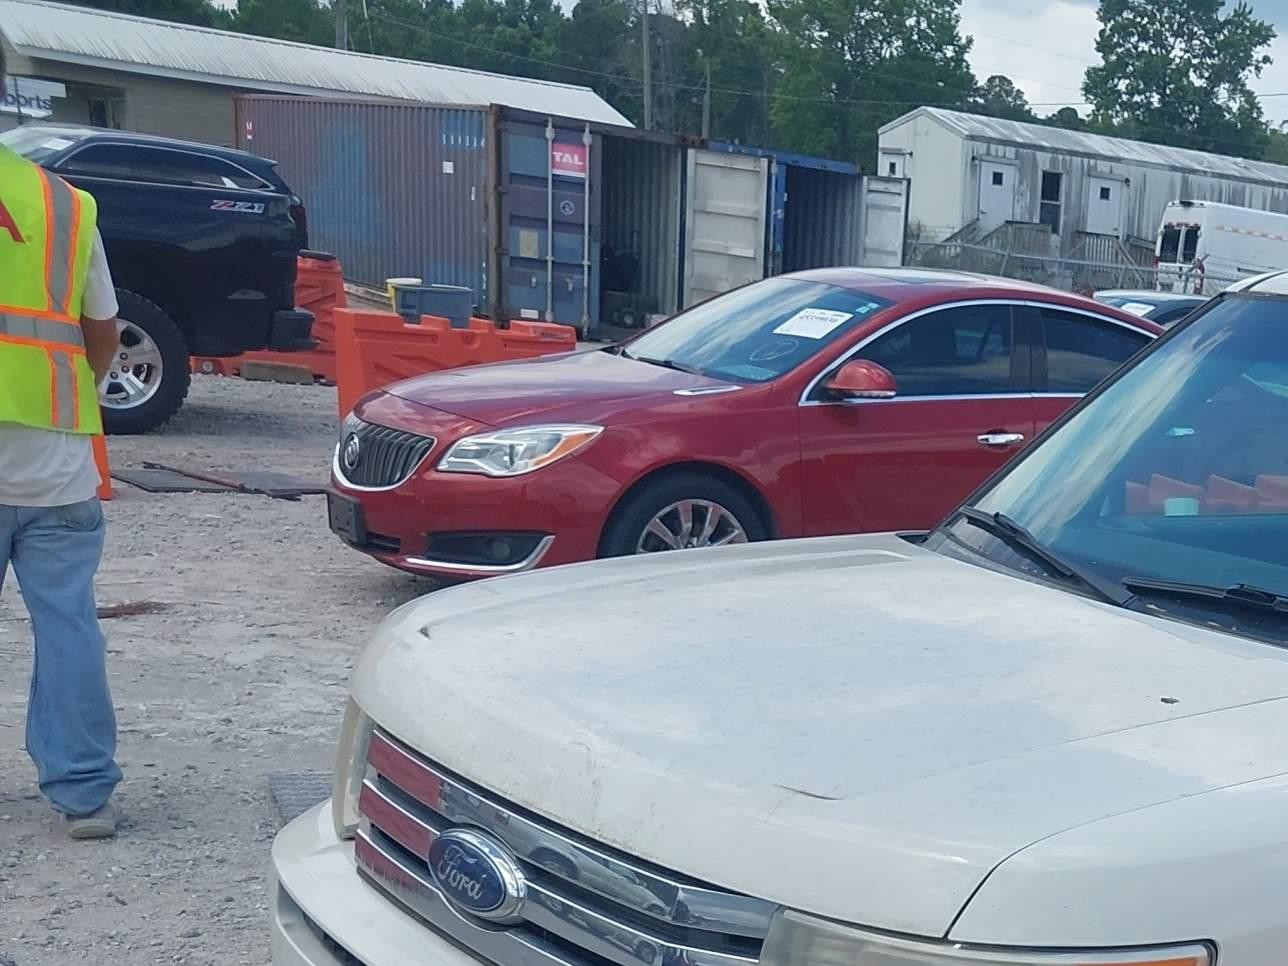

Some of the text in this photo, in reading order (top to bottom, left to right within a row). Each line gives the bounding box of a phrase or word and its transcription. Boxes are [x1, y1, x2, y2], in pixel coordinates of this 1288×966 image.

[4, 93, 53, 110] ports
[552, 151, 584, 165] TAL
[438, 844, 486, 900] Ford
